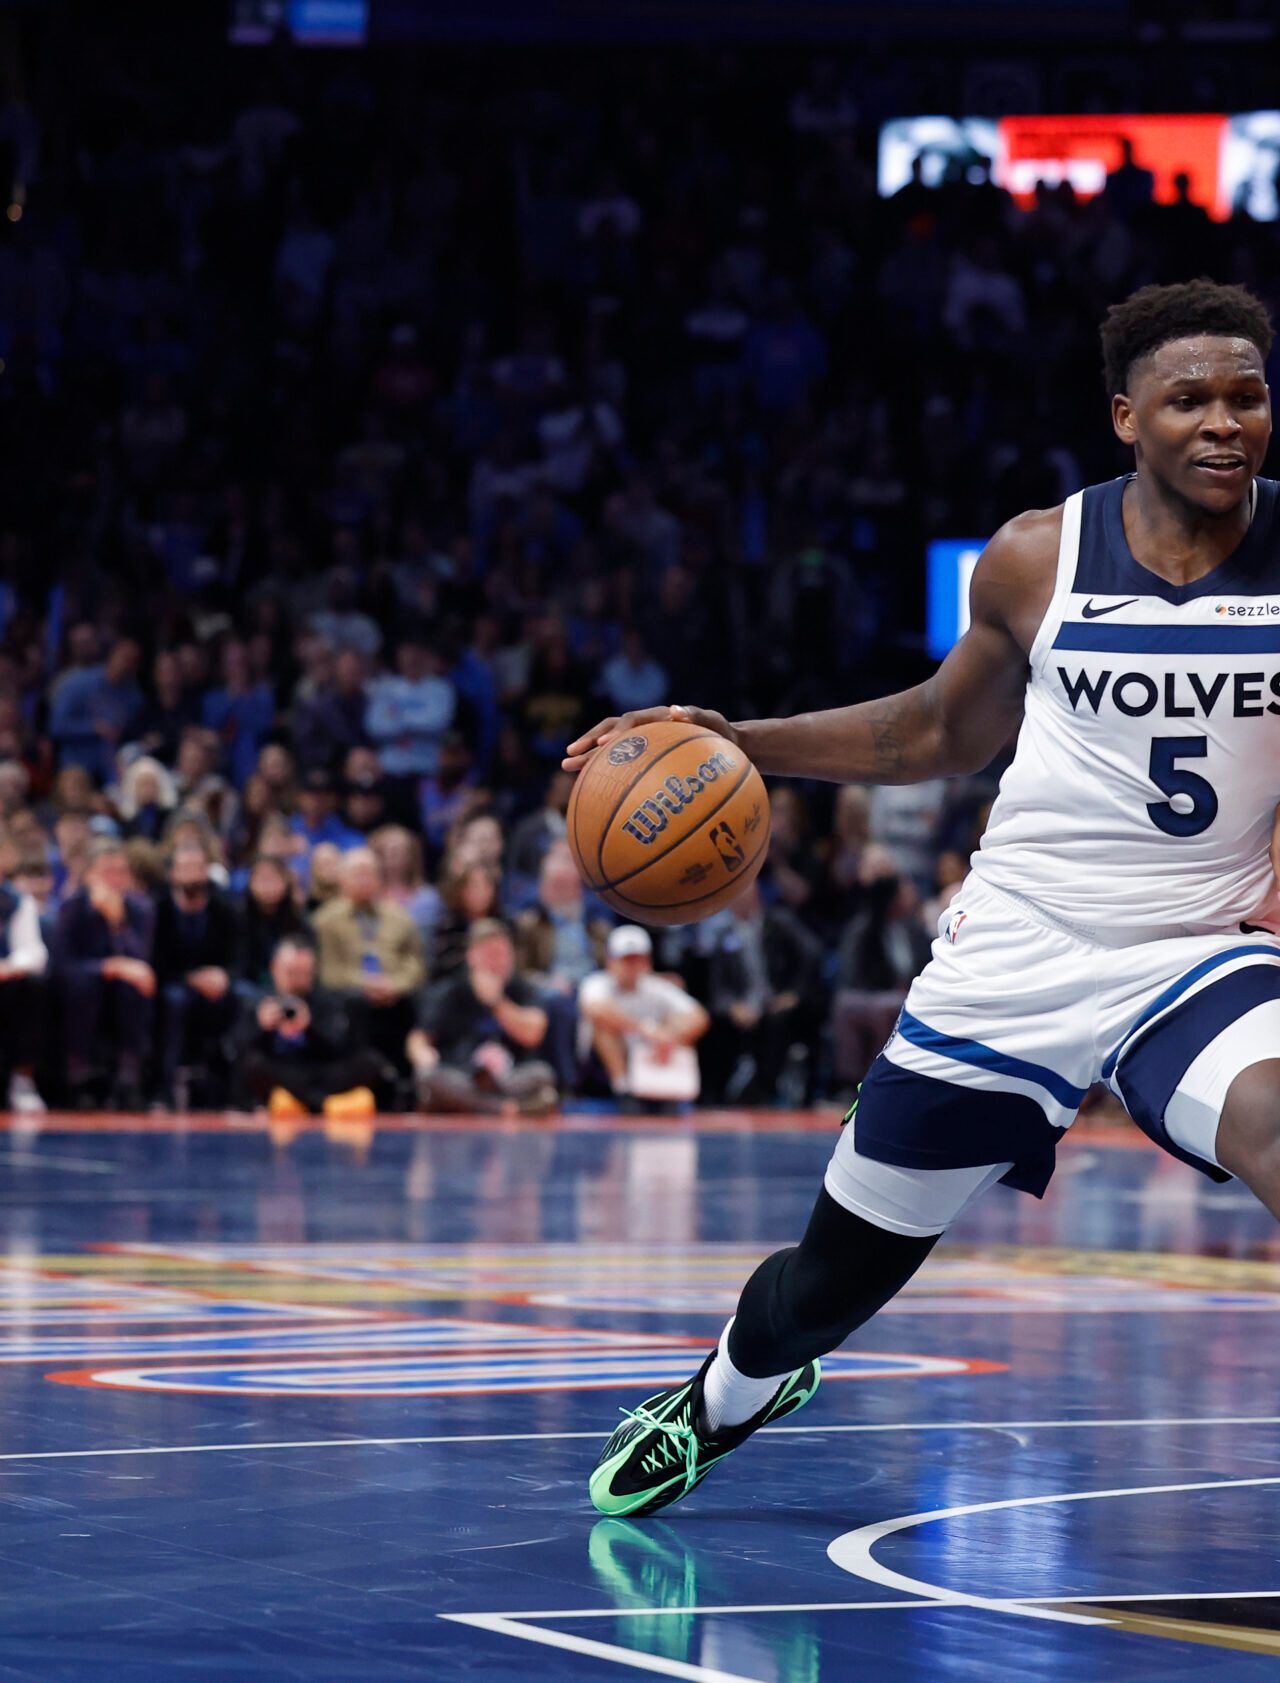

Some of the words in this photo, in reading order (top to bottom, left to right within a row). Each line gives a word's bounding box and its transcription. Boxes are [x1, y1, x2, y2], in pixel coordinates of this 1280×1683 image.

[1227, 602, 1280, 617] sezzle
[621, 752, 737, 845] Wilson
[1146, 735, 1218, 837] 5
